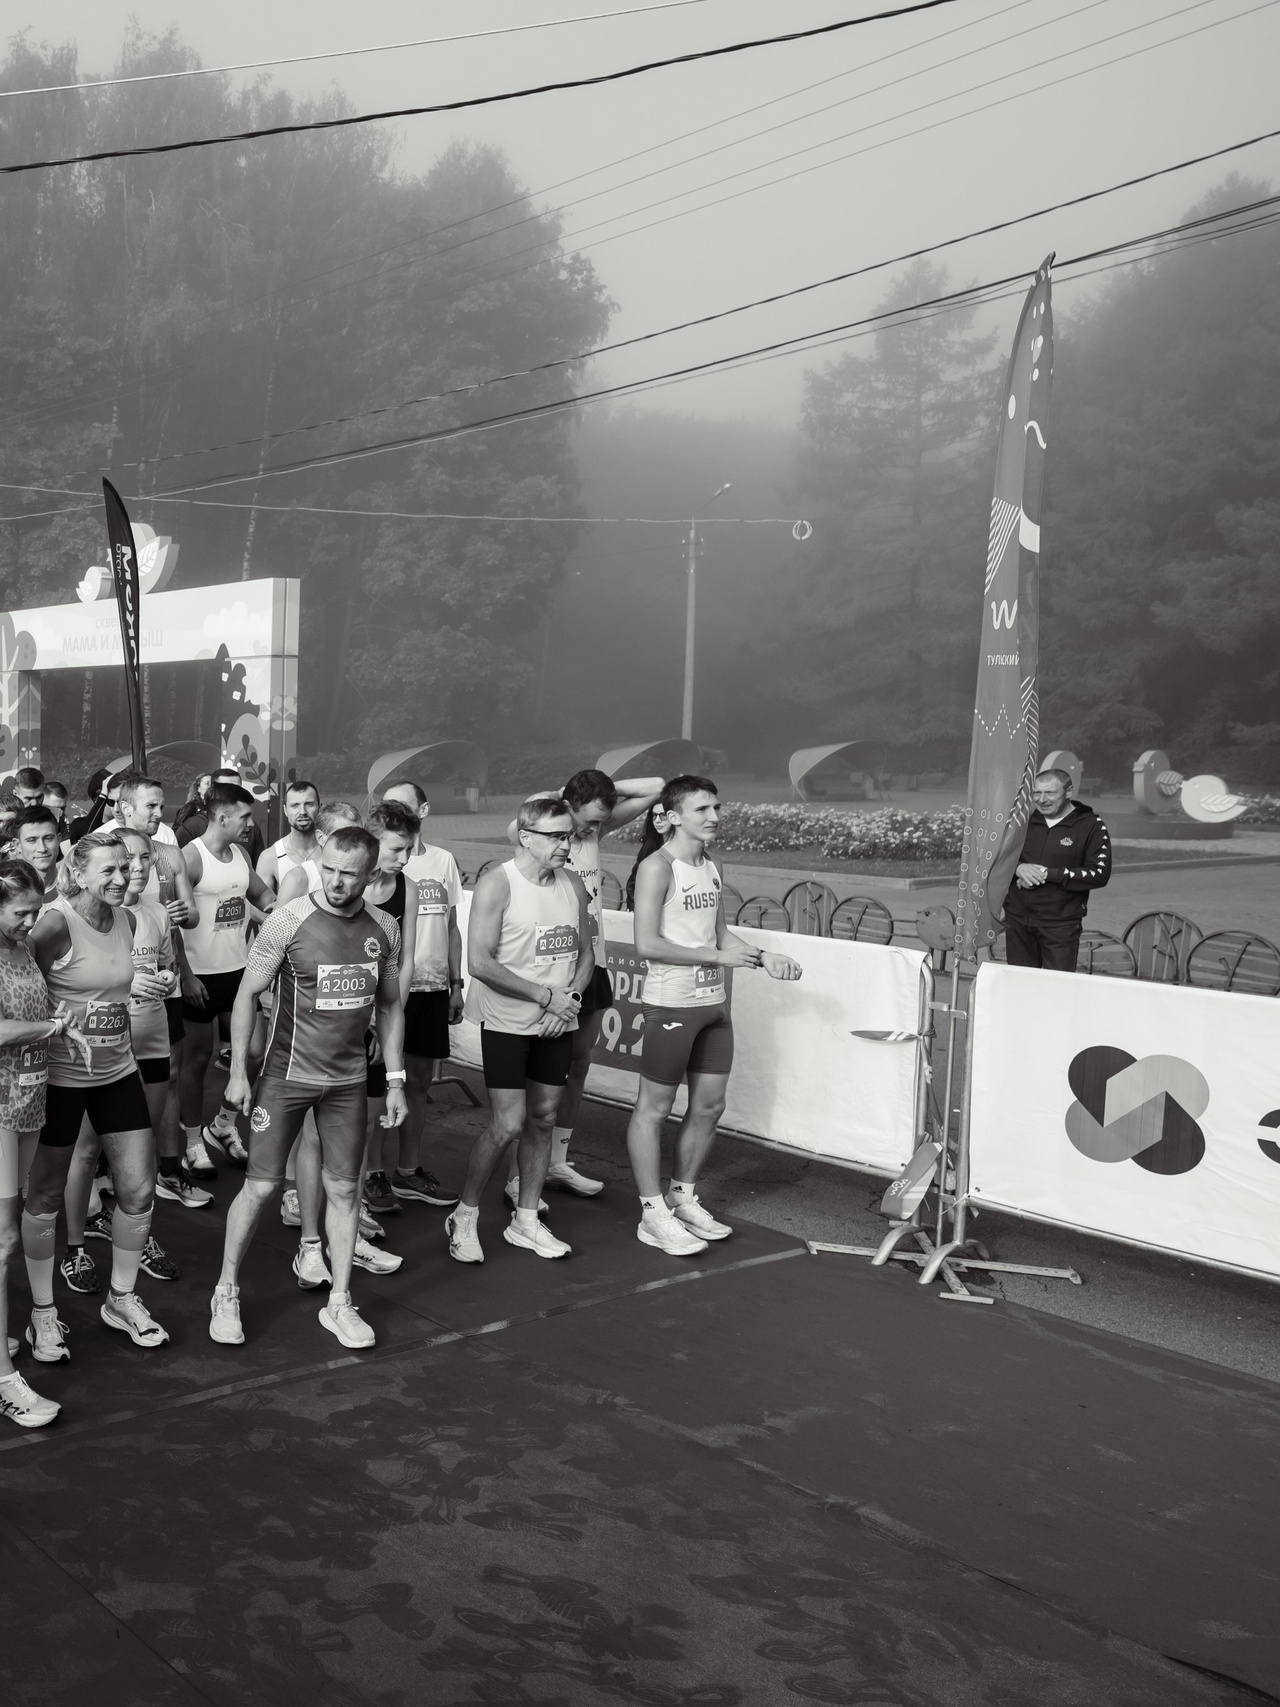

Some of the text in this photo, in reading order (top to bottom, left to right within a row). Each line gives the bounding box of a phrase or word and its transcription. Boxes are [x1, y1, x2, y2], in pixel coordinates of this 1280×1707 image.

[62, 637, 97, 654] МАМА
[112, 629, 163, 651] МЫШ
[418, 888, 442, 900] 2014
[683, 891, 720, 911] RUSSI
[225, 905, 242, 917] 2051
[548, 935, 574, 949] 2028
[333, 977, 366, 992] 2003
[98, 1015, 125, 1029] 2263
